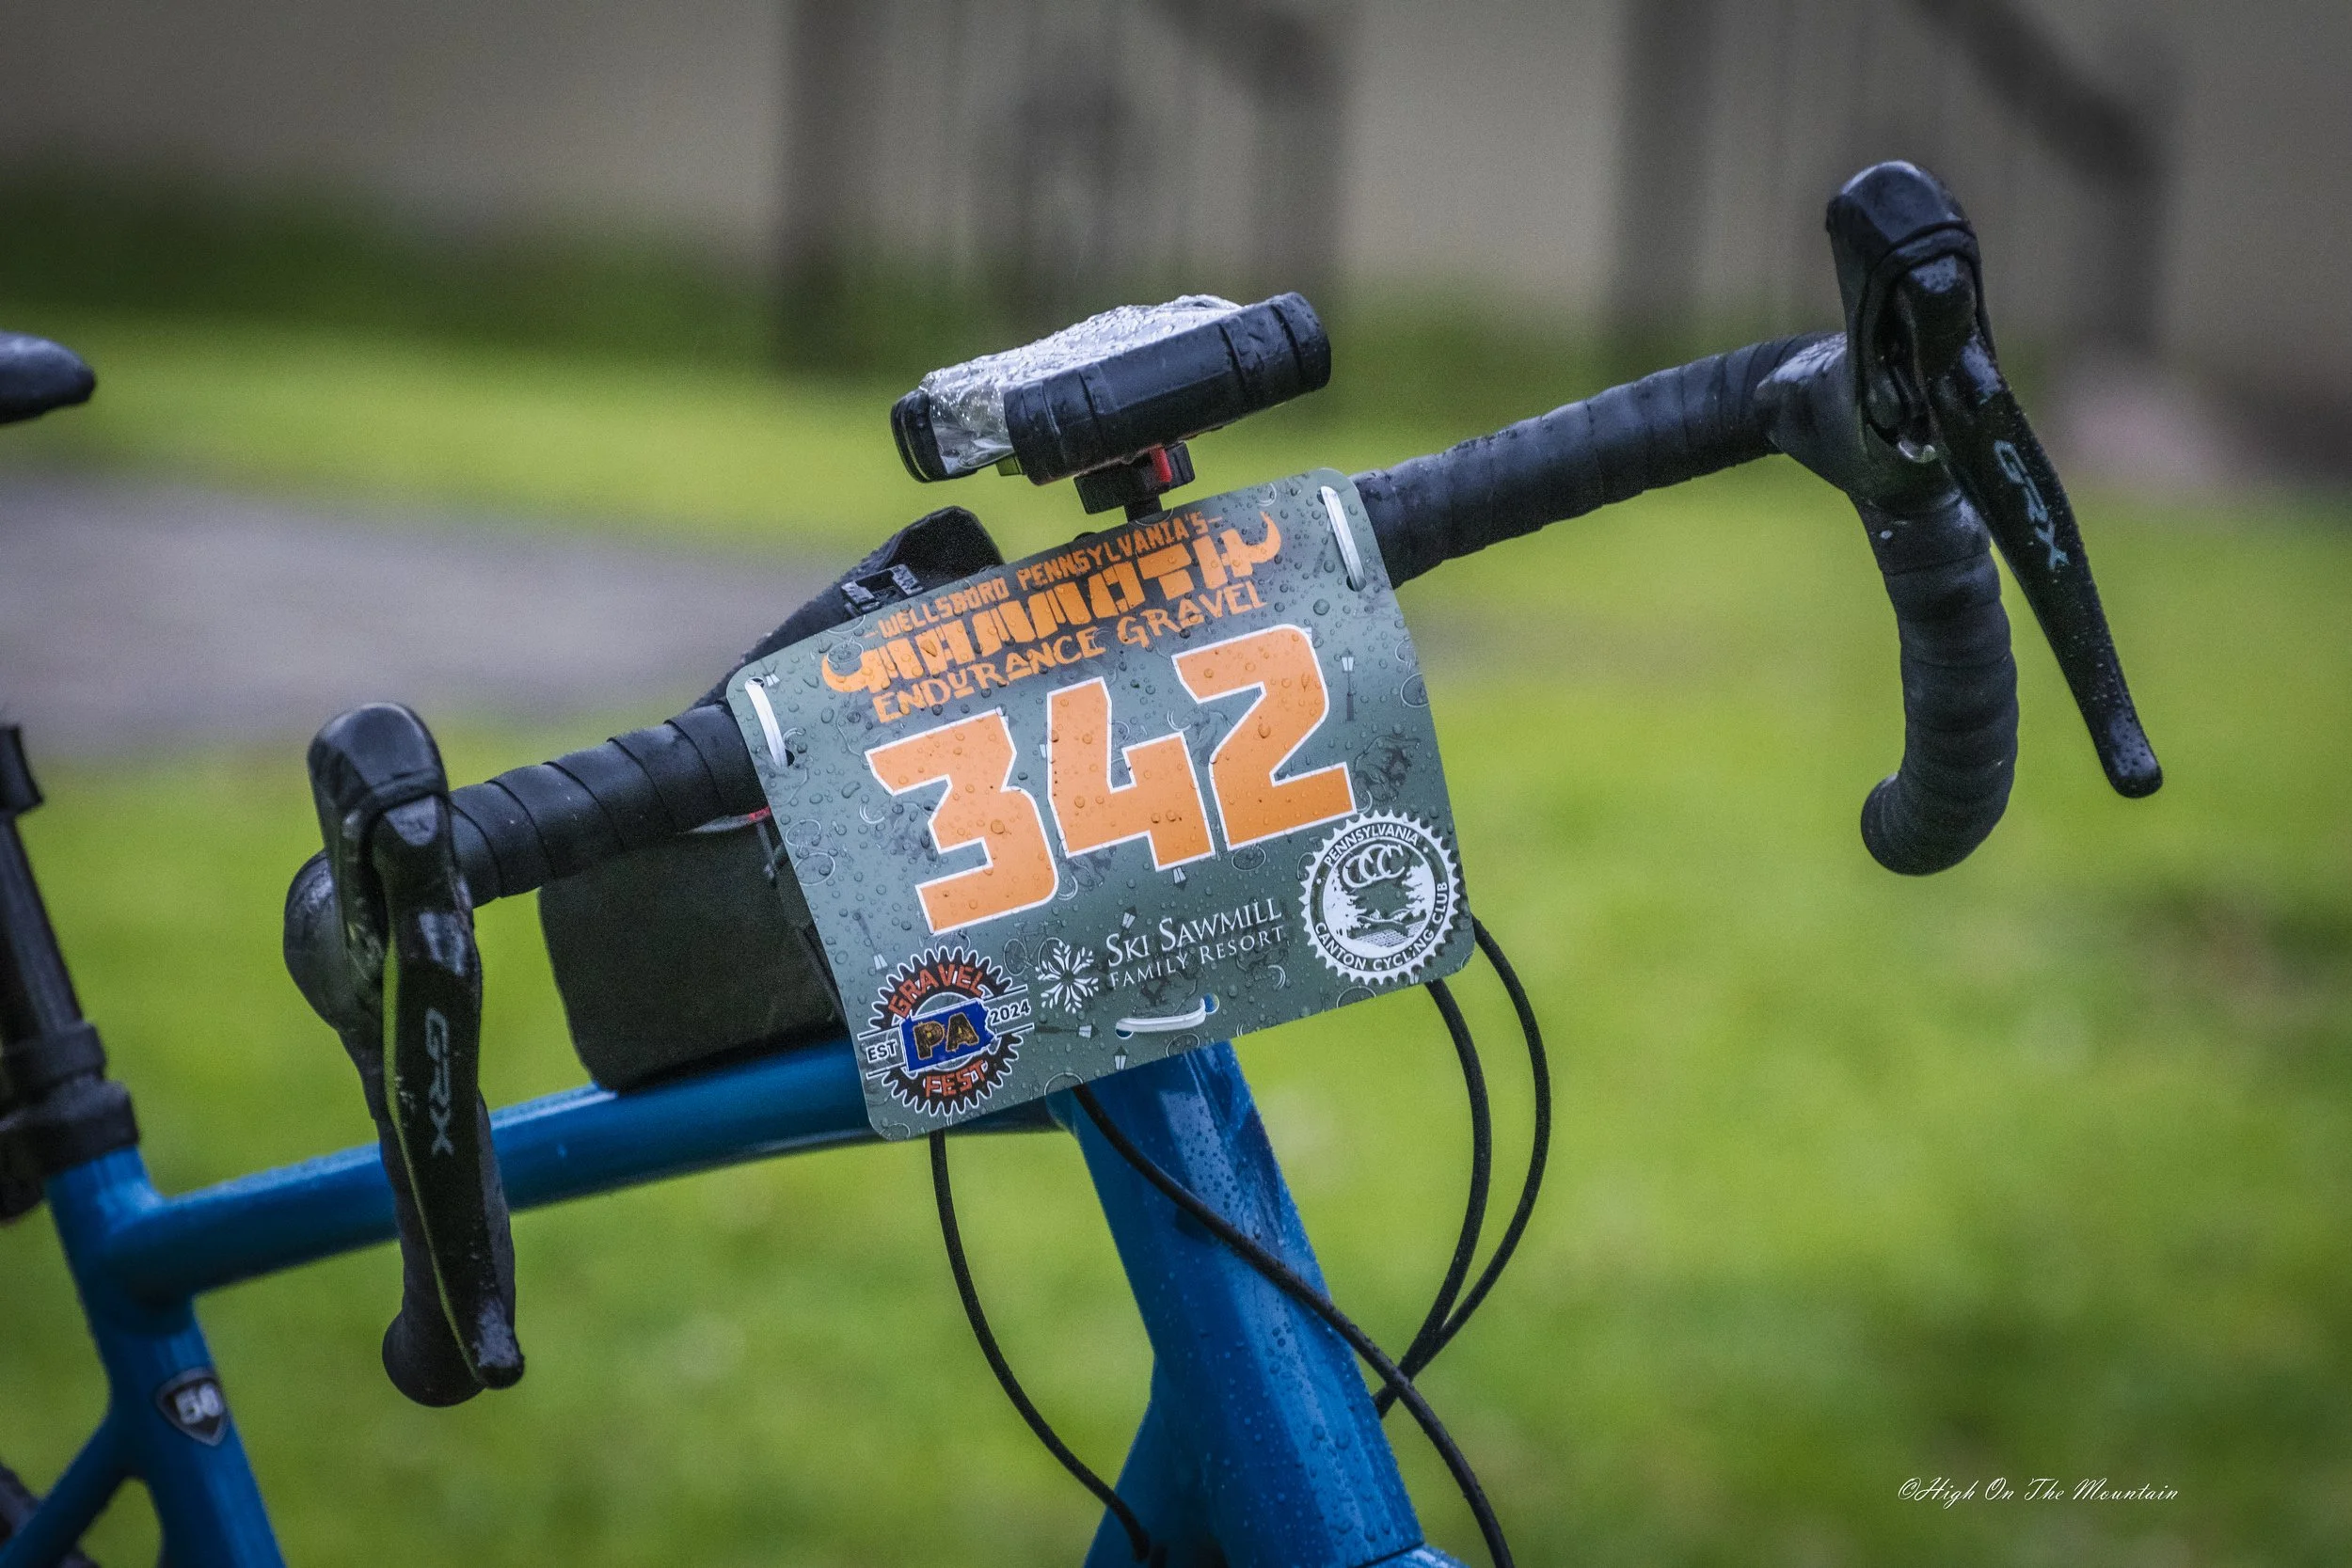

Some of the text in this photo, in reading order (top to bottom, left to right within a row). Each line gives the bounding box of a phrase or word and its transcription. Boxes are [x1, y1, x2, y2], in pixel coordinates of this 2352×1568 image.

[1994, 440, 2070, 570] GRX
[821, 511, 1281, 693] MAMMOTH
[878, 511, 1209, 639] WELLSBORO PENNSYLVANIA'S
[871, 581, 1267, 723] ENDURANCE GRAVEL
[866, 623, 1357, 935] 342
[1323, 823, 1419, 867] PENNSYLVANIA
[1109, 925, 1285, 990] FAMILY RESORT
[1315, 881, 1449, 972] CANTON CYCLING CLUB
[887, 962, 984, 1019] GRAVEL
[990, 999, 1031, 1025] 2024
[866, 1039, 898, 1062] EST
[913, 1011, 980, 1060] PA
[424, 1006, 455, 1158] GRX
[925, 1059, 987, 1099] FEST
